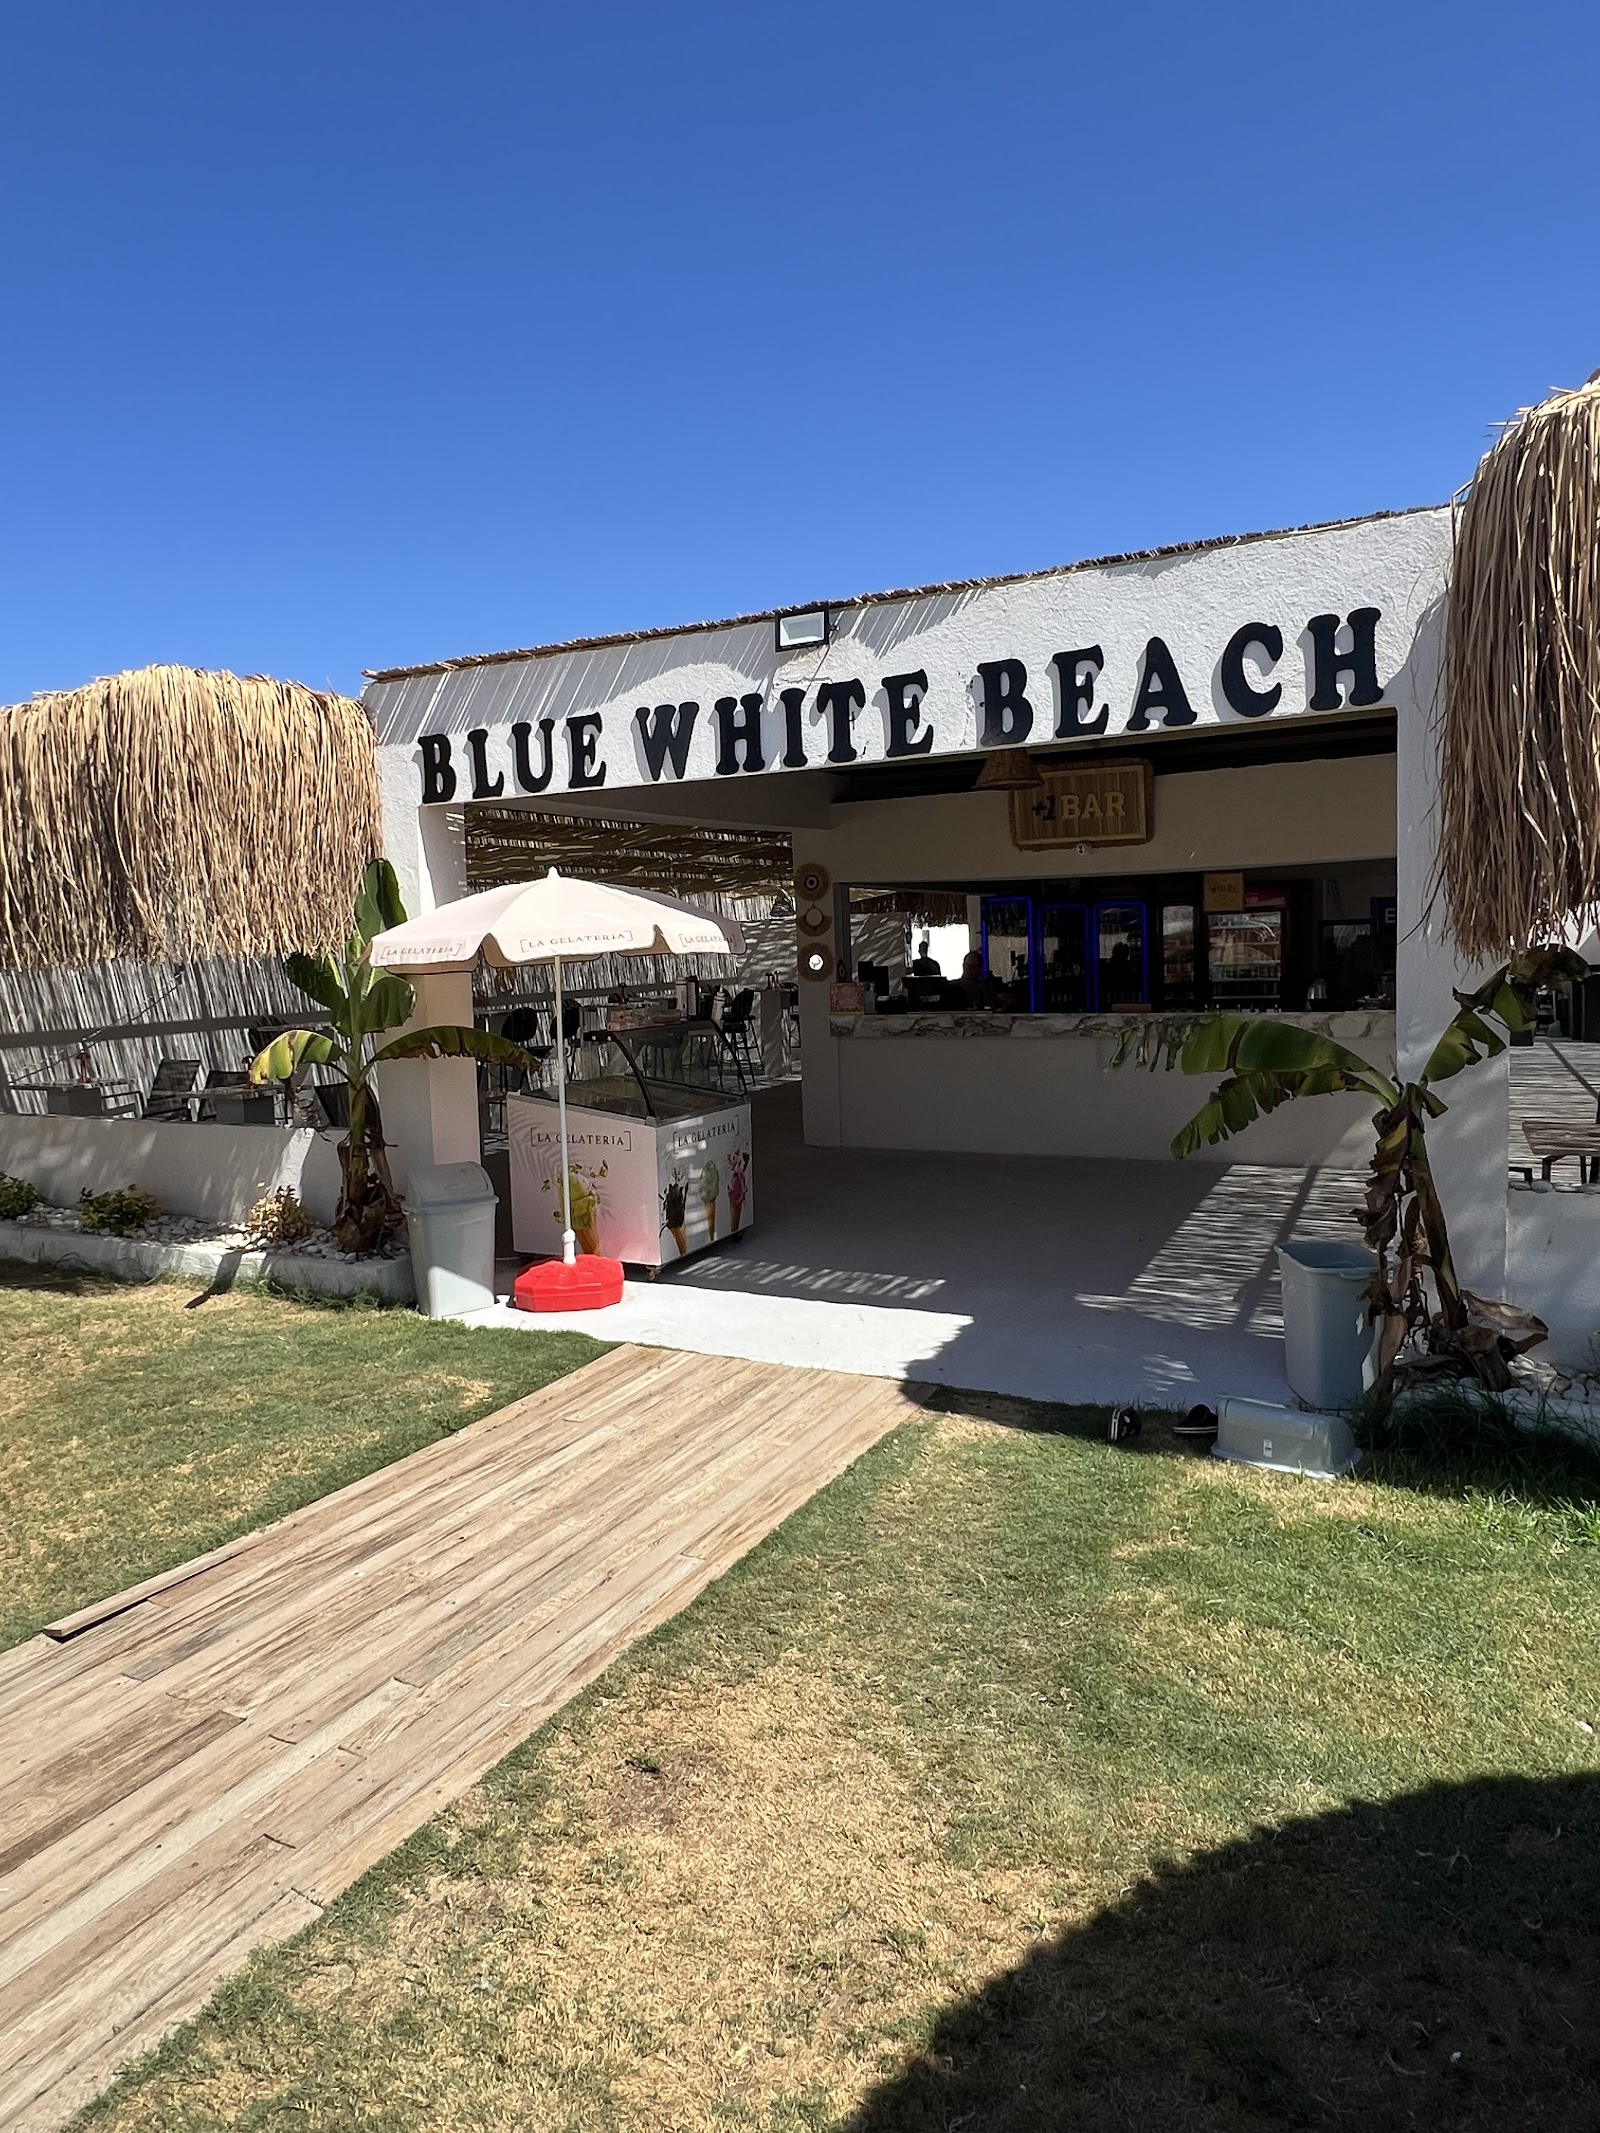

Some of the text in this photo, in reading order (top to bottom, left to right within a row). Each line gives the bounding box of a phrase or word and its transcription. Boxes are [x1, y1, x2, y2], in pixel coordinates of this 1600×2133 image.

[418, 606, 1384, 804] BLUE WHITE BEACH
[1060, 791, 1126, 819] BAR
